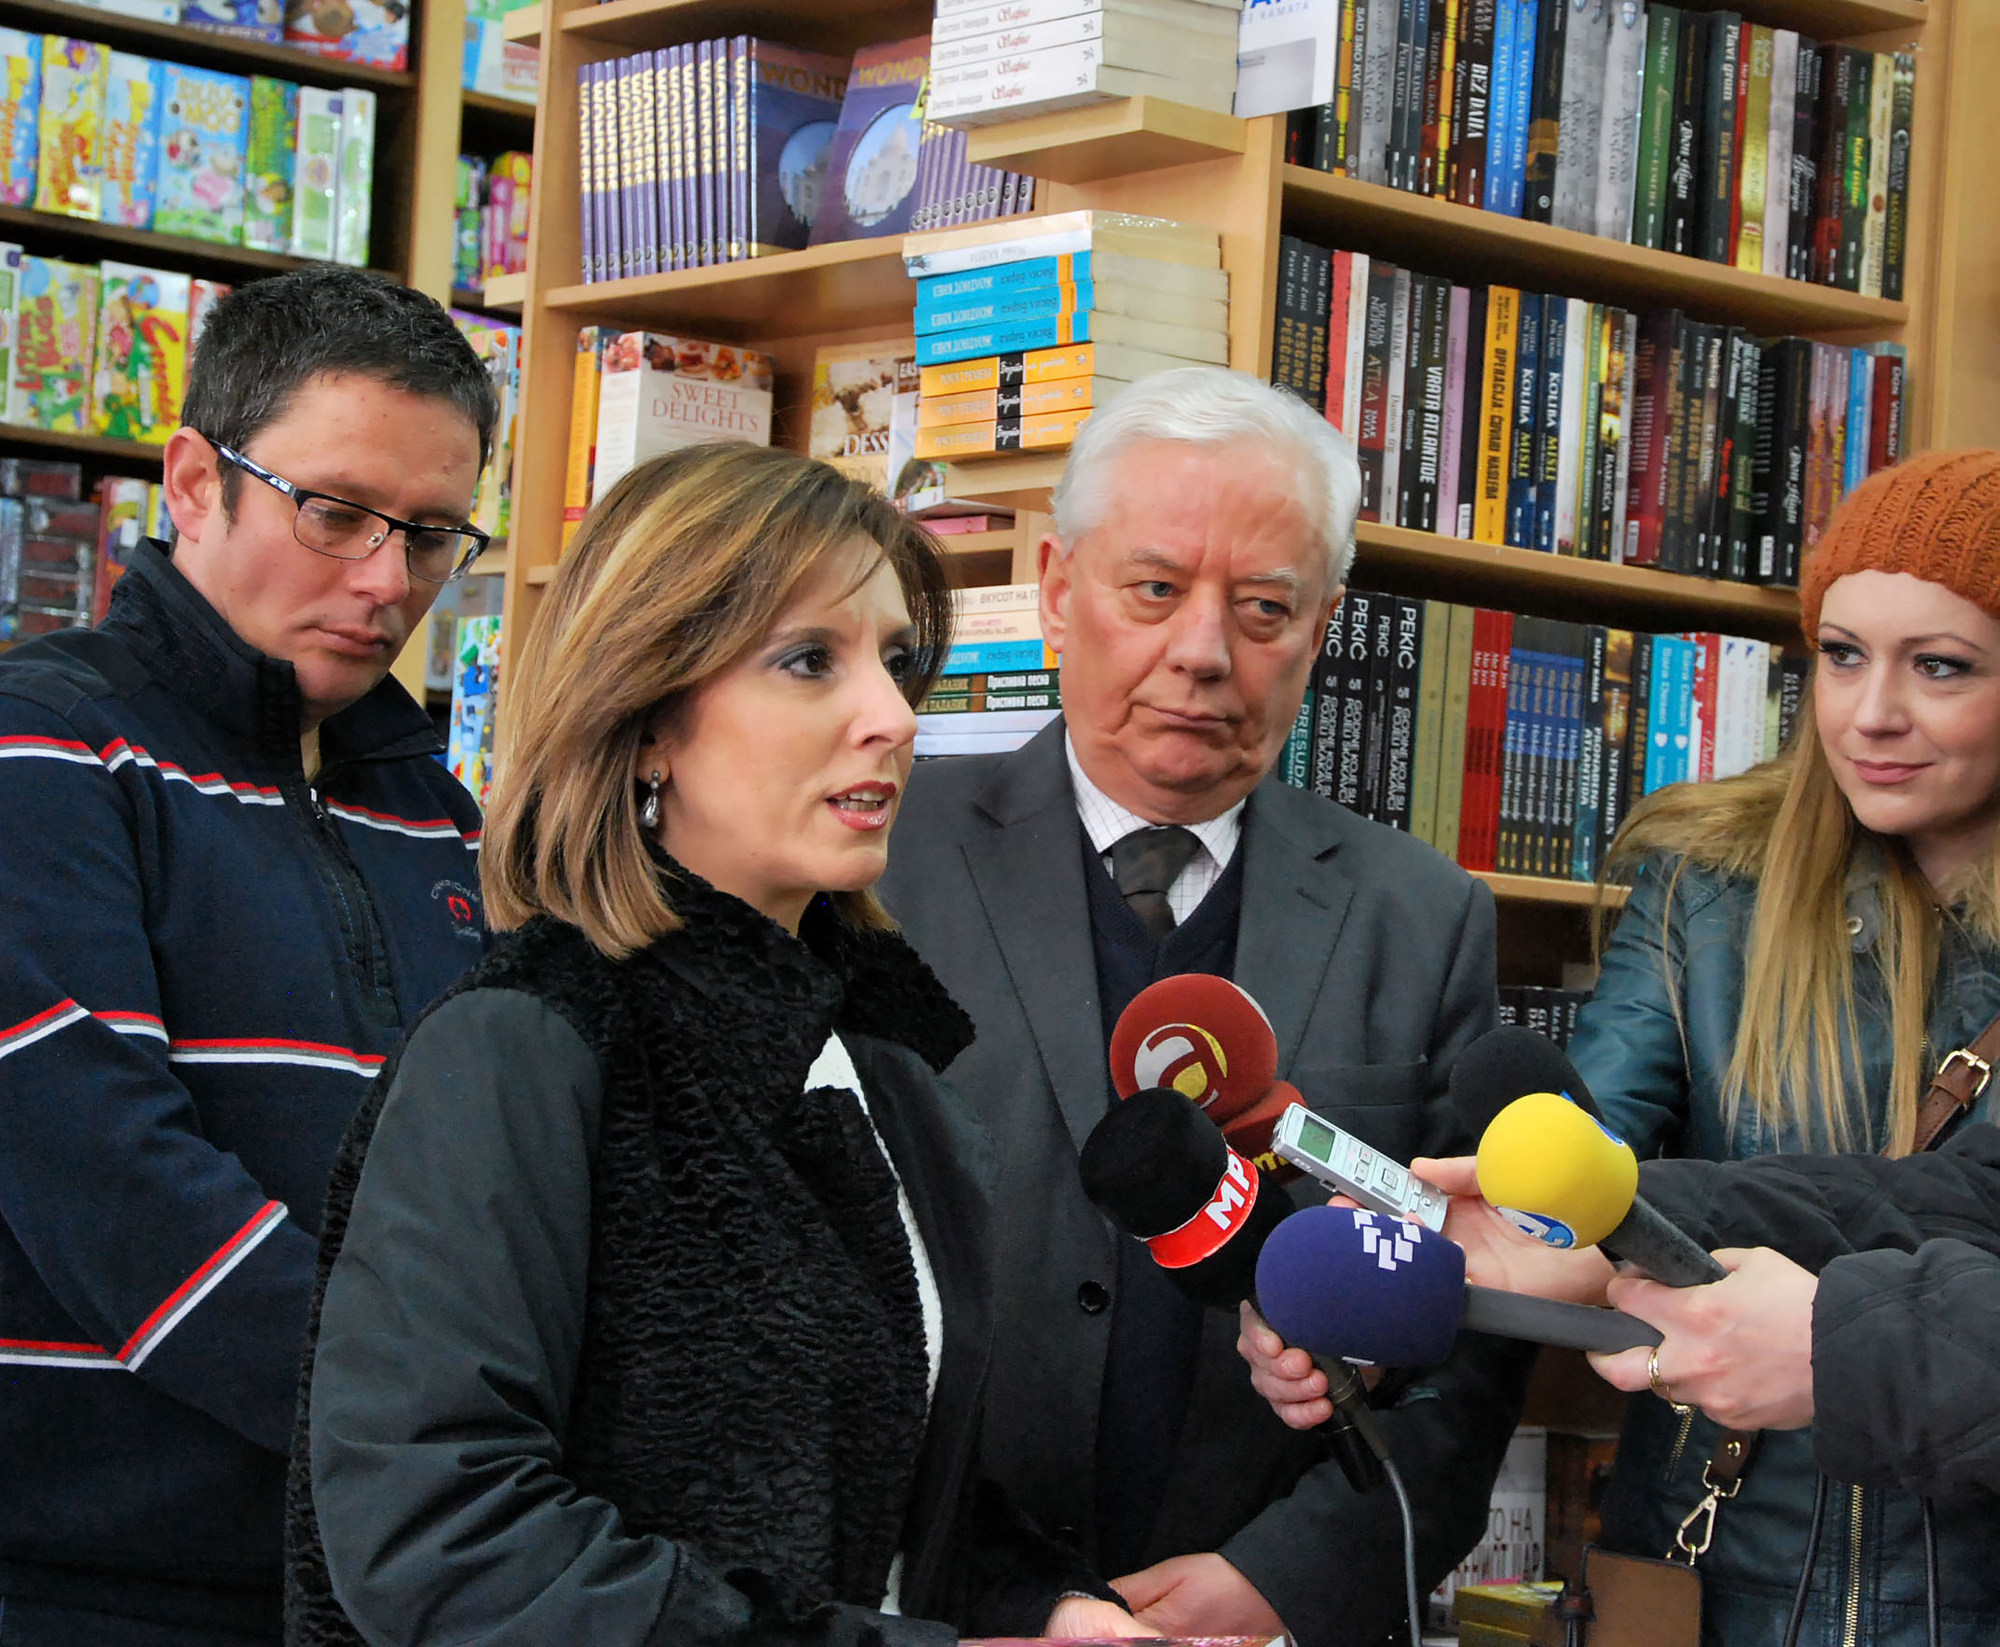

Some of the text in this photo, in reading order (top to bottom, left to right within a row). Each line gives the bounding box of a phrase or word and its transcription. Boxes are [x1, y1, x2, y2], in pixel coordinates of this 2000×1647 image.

[1352, 6, 1366, 91] SAD SMO KVIT
[1724, 24, 1739, 61] Plavi
[1470, 63, 1489, 95] BEZ
[1721, 63, 1735, 101] grom
[1467, 97, 1486, 139] DAHA
[1410, 332, 1421, 369] BASARA
[671, 381, 740, 410] SWEET
[1365, 353, 1381, 402] ATILA
[1426, 366, 1443, 410] VRATA
[1891, 366, 1902, 395] DON
[652, 399, 759, 433] DELIGHTS
[1518, 368, 1535, 478] KOLIBA MISLI
[1545, 372, 1561, 481] KOLIBA MISLI
[843, 431, 889, 457] DESS
[1419, 413, 1439, 485] ATLANTIDE
[1016, 589, 1029, 602] НА
[1350, 598, 1369, 662] PEKIĆ
[1376, 615, 1390, 658] PEKIĆ
[1398, 606, 1417, 670] PEKIĆ
[1295, 703, 1310, 789] PRESUDA
[1314, 695, 1331, 795] POJELI SKAKAVC
[1326, 697, 1339, 748] GODINE
[1350, 701, 1363, 751] GODINE
[1398, 708, 1412, 759] GODINE
[1323, 751, 1335, 783] KOJE
[1338, 698, 1355, 803] POJELI SKAKAVCI
[1347, 754, 1359, 785] KOJE
[1387, 706, 1403, 811] POJELI SKAKAVCI
[1580, 728, 1592, 806] ATLANTIDA
[1396, 762, 1408, 792] KOJE
[1606, 749, 1619, 836] NEPOKOREN
